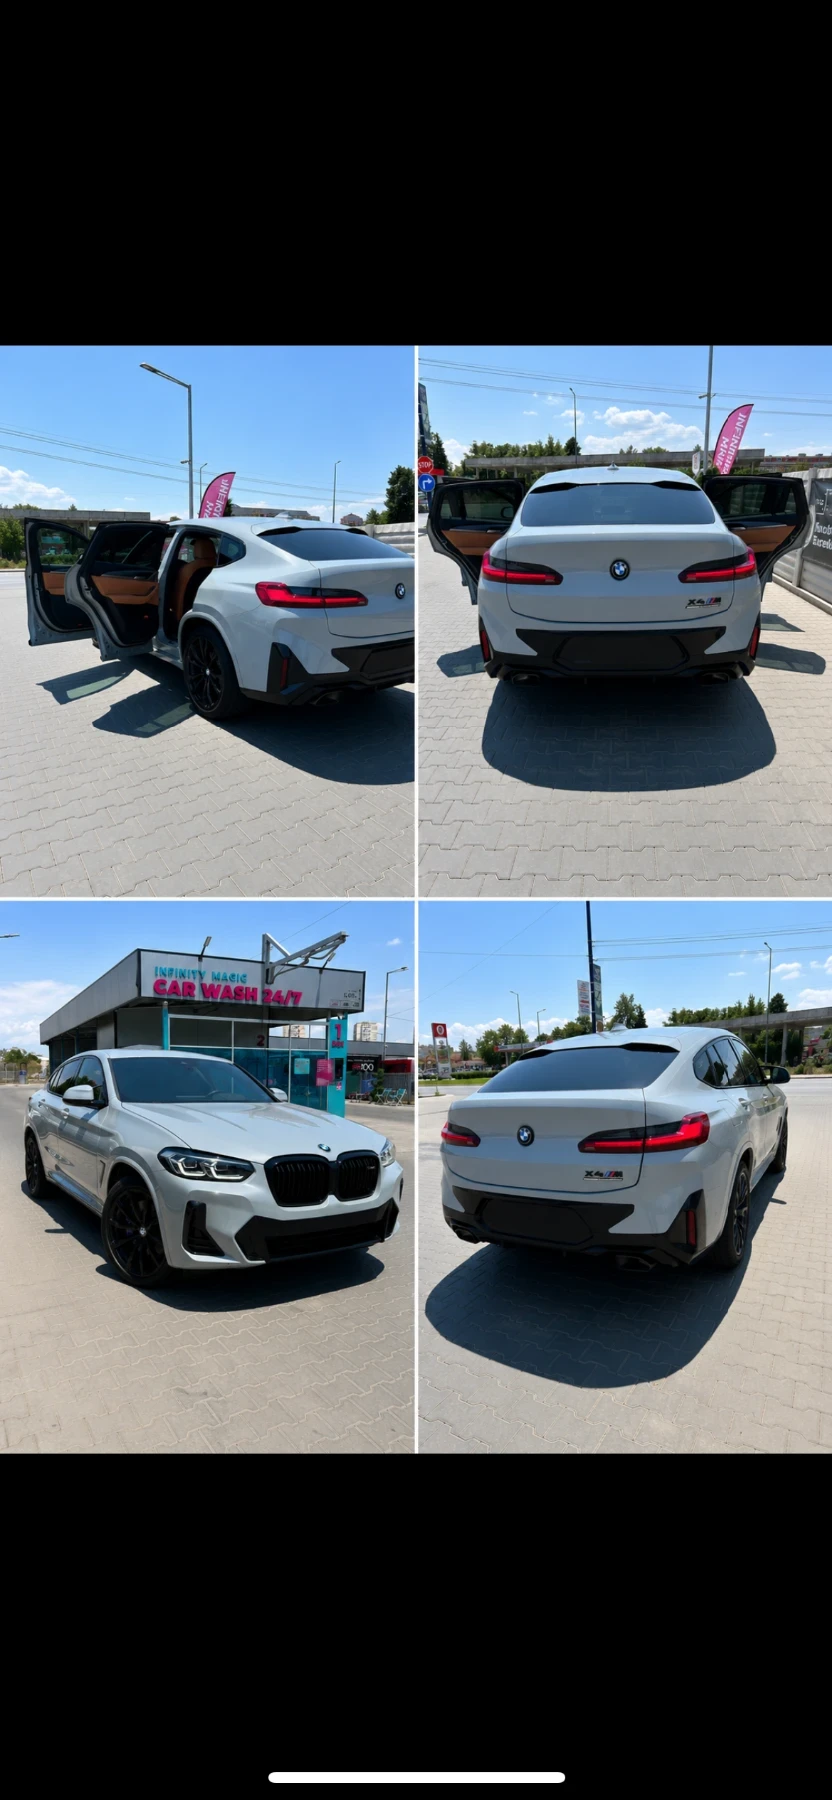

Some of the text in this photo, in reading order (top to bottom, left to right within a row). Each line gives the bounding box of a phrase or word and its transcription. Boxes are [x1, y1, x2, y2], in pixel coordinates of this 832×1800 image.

[418, 461, 432, 469] STOP
[154, 966, 247, 984] INFINITY MAGIC
[153, 979, 303, 1006] CAR WASH 24/7
[256, 1034, 265, 1046] 2
